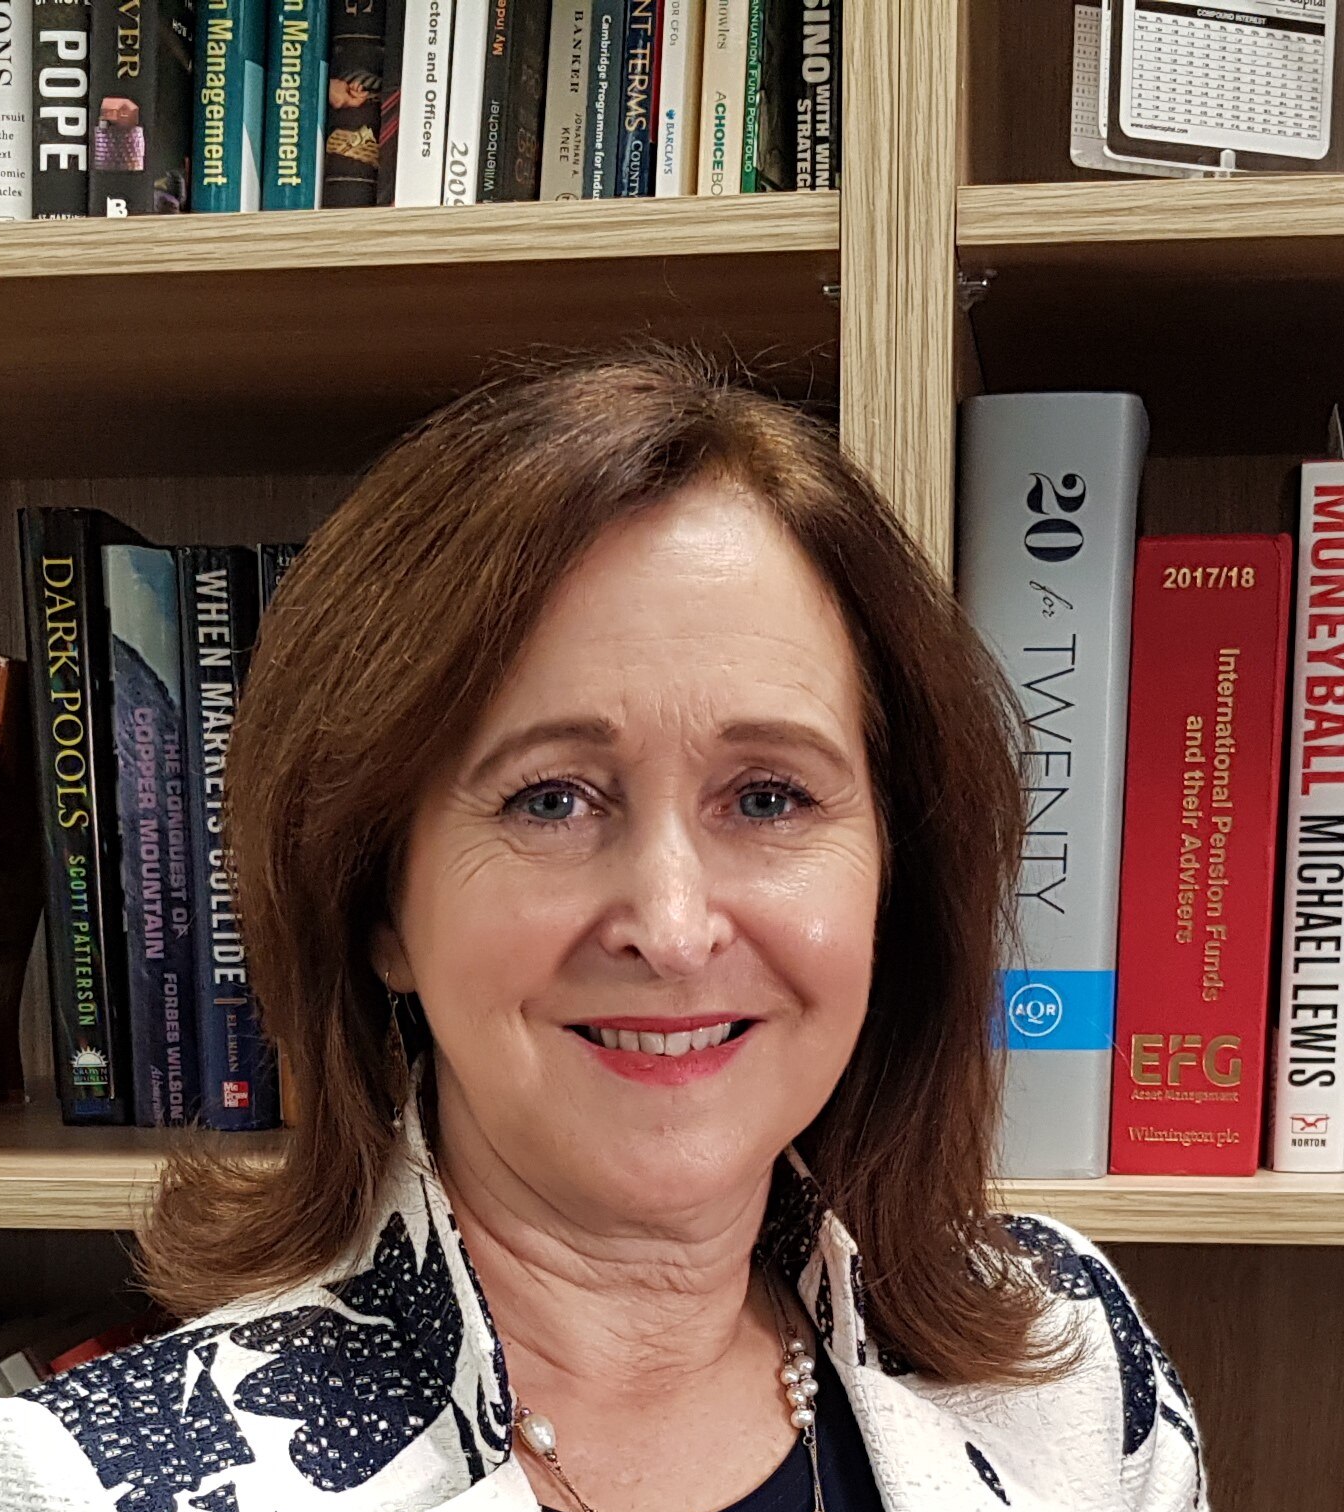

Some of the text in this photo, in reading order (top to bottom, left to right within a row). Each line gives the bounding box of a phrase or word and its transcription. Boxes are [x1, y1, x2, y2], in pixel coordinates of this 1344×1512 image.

[38, 30, 88, 172] POPE
[201, 19, 233, 186] Management
[275, 20, 309, 187] Management
[420, 51, 438, 158] and Officers
[570, 10, 584, 94] BANKER
[594, 14, 612, 149] Cambridge Programme
[560, 127, 571, 163] KNEE
[664, 122, 674, 175] BARCLAYS
[744, 69, 759, 173] FUND PORTFOLIO
[194, 568, 232, 669] WHEN
[1162, 567, 1256, 589] 2017/18
[1014, 472, 1087, 916] 20 TWENTY
[41, 556, 96, 1027] DARK POOLS SCOTT PATTERSON
[133, 707, 166, 960] COPPER MOUNTAIN
[165, 779, 187, 902] CONQUEST
[1175, 715, 1206, 945] and their Advisers
[1202, 648, 1241, 1003] International Pension Funds
[162, 973, 185, 1121] FORBES WILSON
[1130, 1032, 1242, 1088] EFG
[1287, 983, 1340, 1089] LEWIS
[1127, 1126, 1214, 1148] Wilmington
[1130, 1089, 1239, 1103] Asset Management
[1291, 1137, 1327, 1148] NORTON
